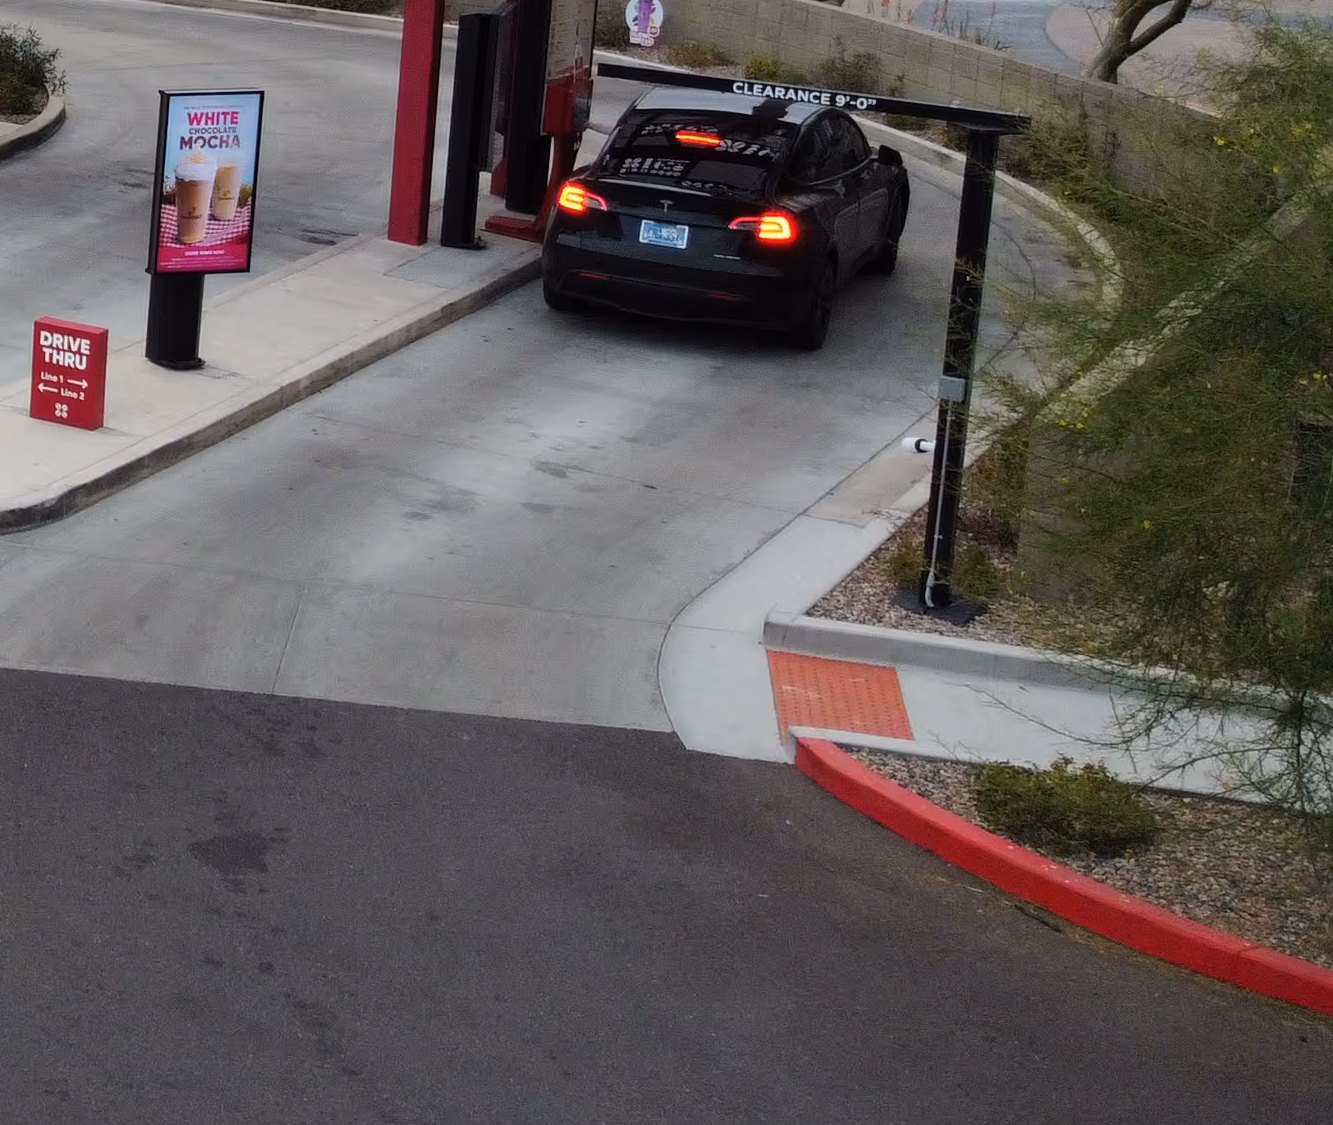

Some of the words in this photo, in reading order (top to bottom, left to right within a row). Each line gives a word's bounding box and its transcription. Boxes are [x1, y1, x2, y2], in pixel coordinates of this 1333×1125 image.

[733, 82, 831, 105] CLEARANCE
[187, 111, 239, 125] WHITE
[179, 135, 241, 150] MOCHA
[40, 330, 90, 355] DRIVE
[42, 347, 87, 370] THRU
[41, 371, 58, 382] Line
[59, 375, 64, 383] 1
[61, 388, 78, 399] Line
[79, 392, 85, 401] 2
